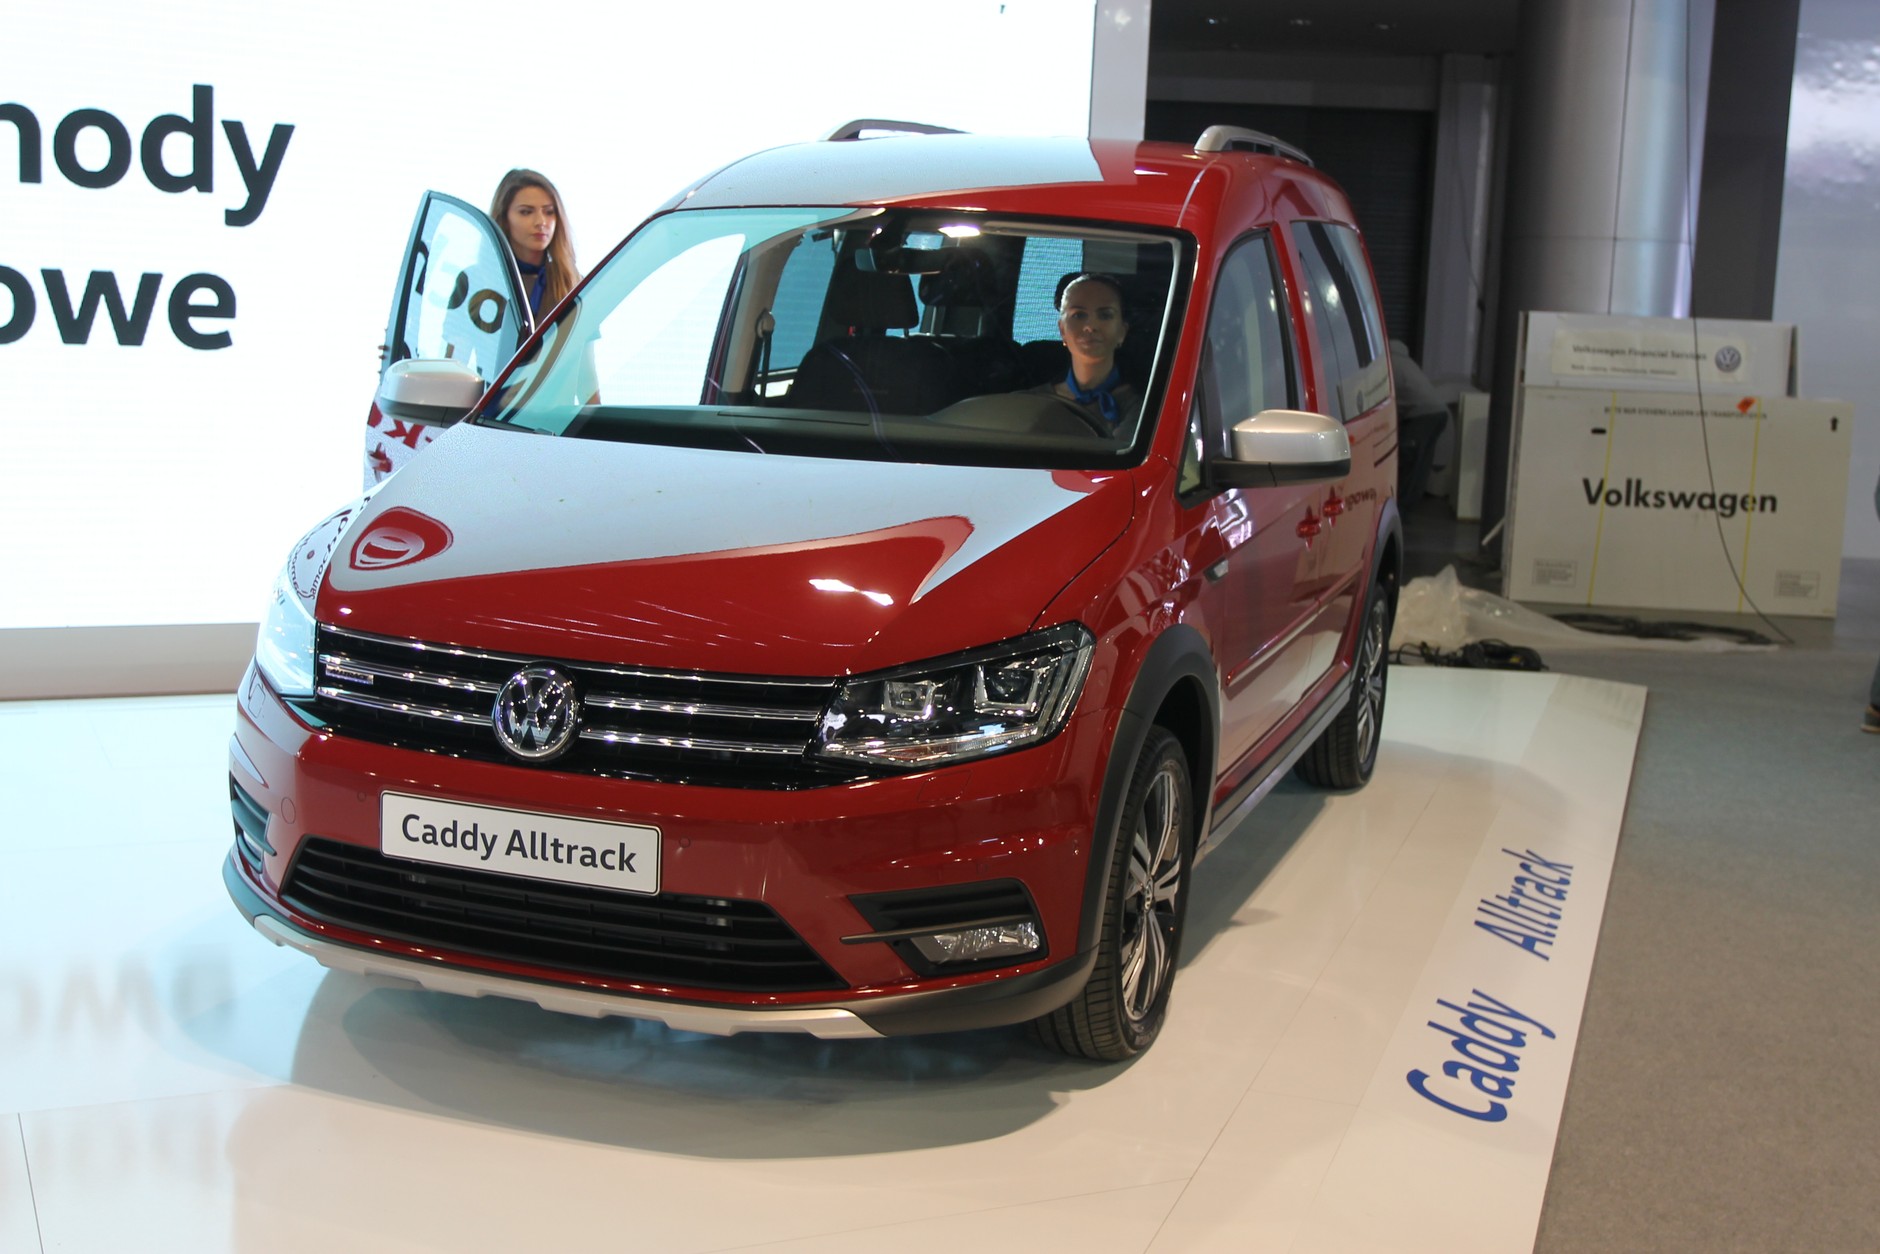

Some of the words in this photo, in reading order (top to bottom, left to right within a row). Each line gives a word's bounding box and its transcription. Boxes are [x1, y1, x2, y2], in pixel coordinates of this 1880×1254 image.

[1582, 478, 1777, 518] Volkswagen
[401, 814, 498, 861] Caddy
[505, 829, 637, 873] Alltrack
[1474, 848, 1574, 961] Alltrack
[1406, 988, 1556, 1123] Caddy
